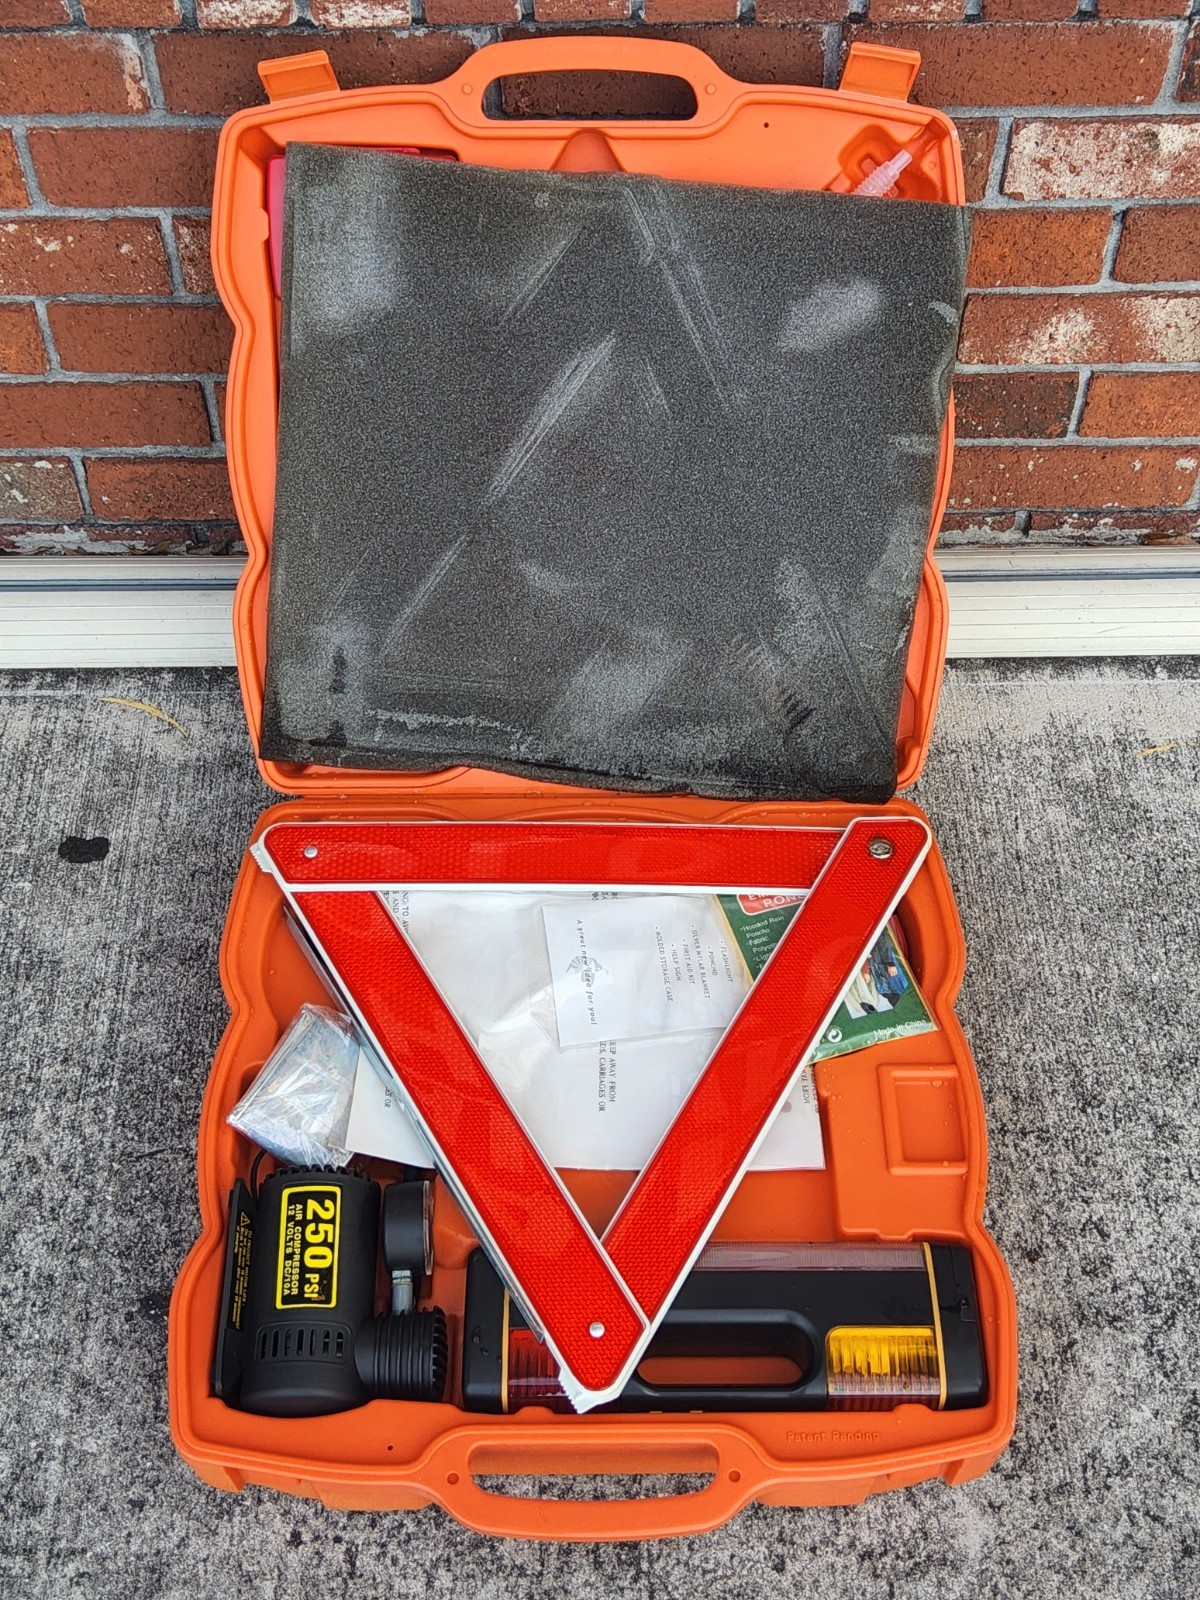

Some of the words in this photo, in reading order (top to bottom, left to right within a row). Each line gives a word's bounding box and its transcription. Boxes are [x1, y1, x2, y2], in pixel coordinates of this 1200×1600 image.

[743, 920, 769, 931] Hooded
[769, 916, 785, 924] Rain
[577, 927, 586, 948] great
[656, 931, 665, 955] MOLDED
[692, 929, 701, 949] SILVER
[746, 928, 771, 939] Poncho
[581, 950, 589, 966] new
[671, 949, 679, 965] HELP
[683, 943, 691, 961] FIRST
[696, 951, 705, 970] MYLAR
[660, 956, 671, 985] STORAGE
[708, 951, 718, 976] PONCHO
[721, 946, 733, 982] FLASHLIGHT
[674, 966, 682, 981] SIGN
[665, 986, 673, 1002] CASE
[700, 972, 711, 999] BLANKET
[585, 991, 594, 1005] for
[588, 1006, 598, 1025] you!
[873, 1027, 894, 1038] Made
[905, 1019, 927, 1029] China
[598, 1057, 606, 1098] CARRIAGES
[598, 1100, 606, 1112] OR
[288, 1205, 295, 1216] 12
[295, 1203, 303, 1221] AIR
[286, 1221, 295, 1254] VOLTS
[304, 1198, 335, 1269] 250
[291, 1226, 302, 1295] COMPRESSOR
[283, 1260, 292, 1296] DC/10A
[304, 1273, 320, 1298] PSI
[787, 1431, 826, 1443] Patent
